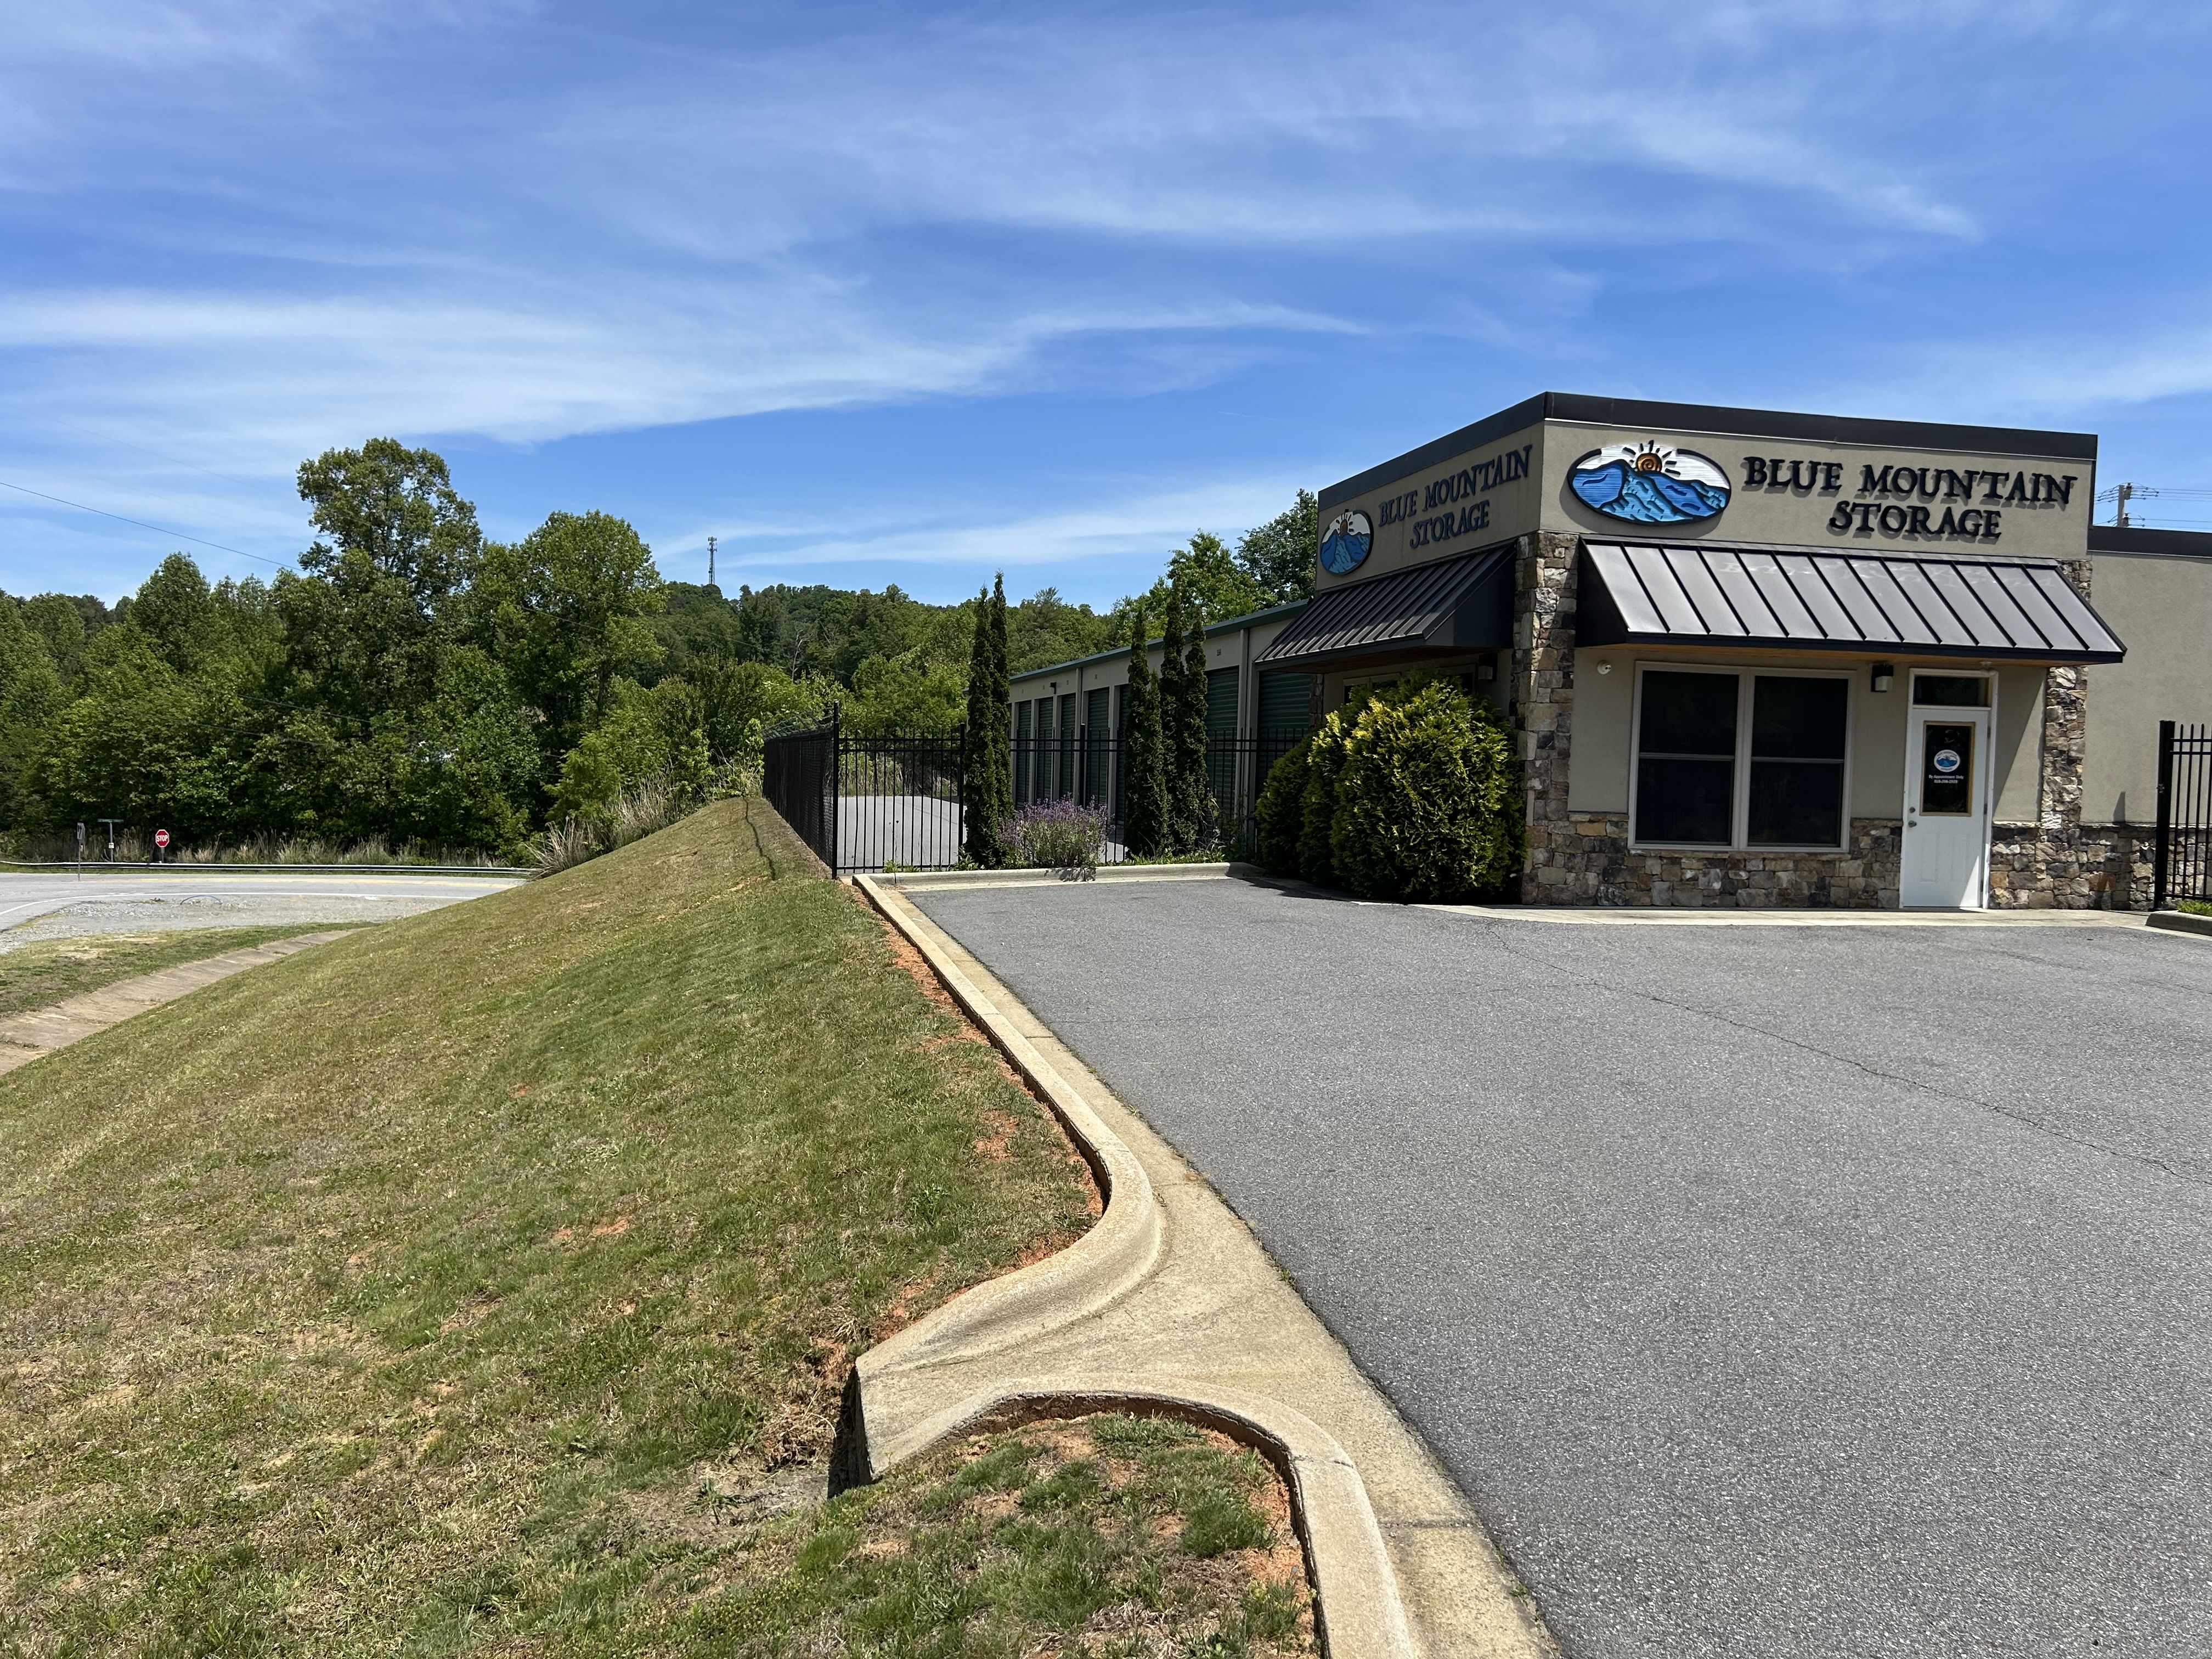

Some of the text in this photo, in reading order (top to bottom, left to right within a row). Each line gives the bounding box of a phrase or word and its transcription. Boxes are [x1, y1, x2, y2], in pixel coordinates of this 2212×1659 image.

[1378, 444, 1532, 527] BLUE MOUNTAIN
[1743, 456, 2078, 504] BLUE MOUNTAIN
[1409, 500, 1490, 549] STORAGE
[1829, 500, 2002, 538] STORAGE
